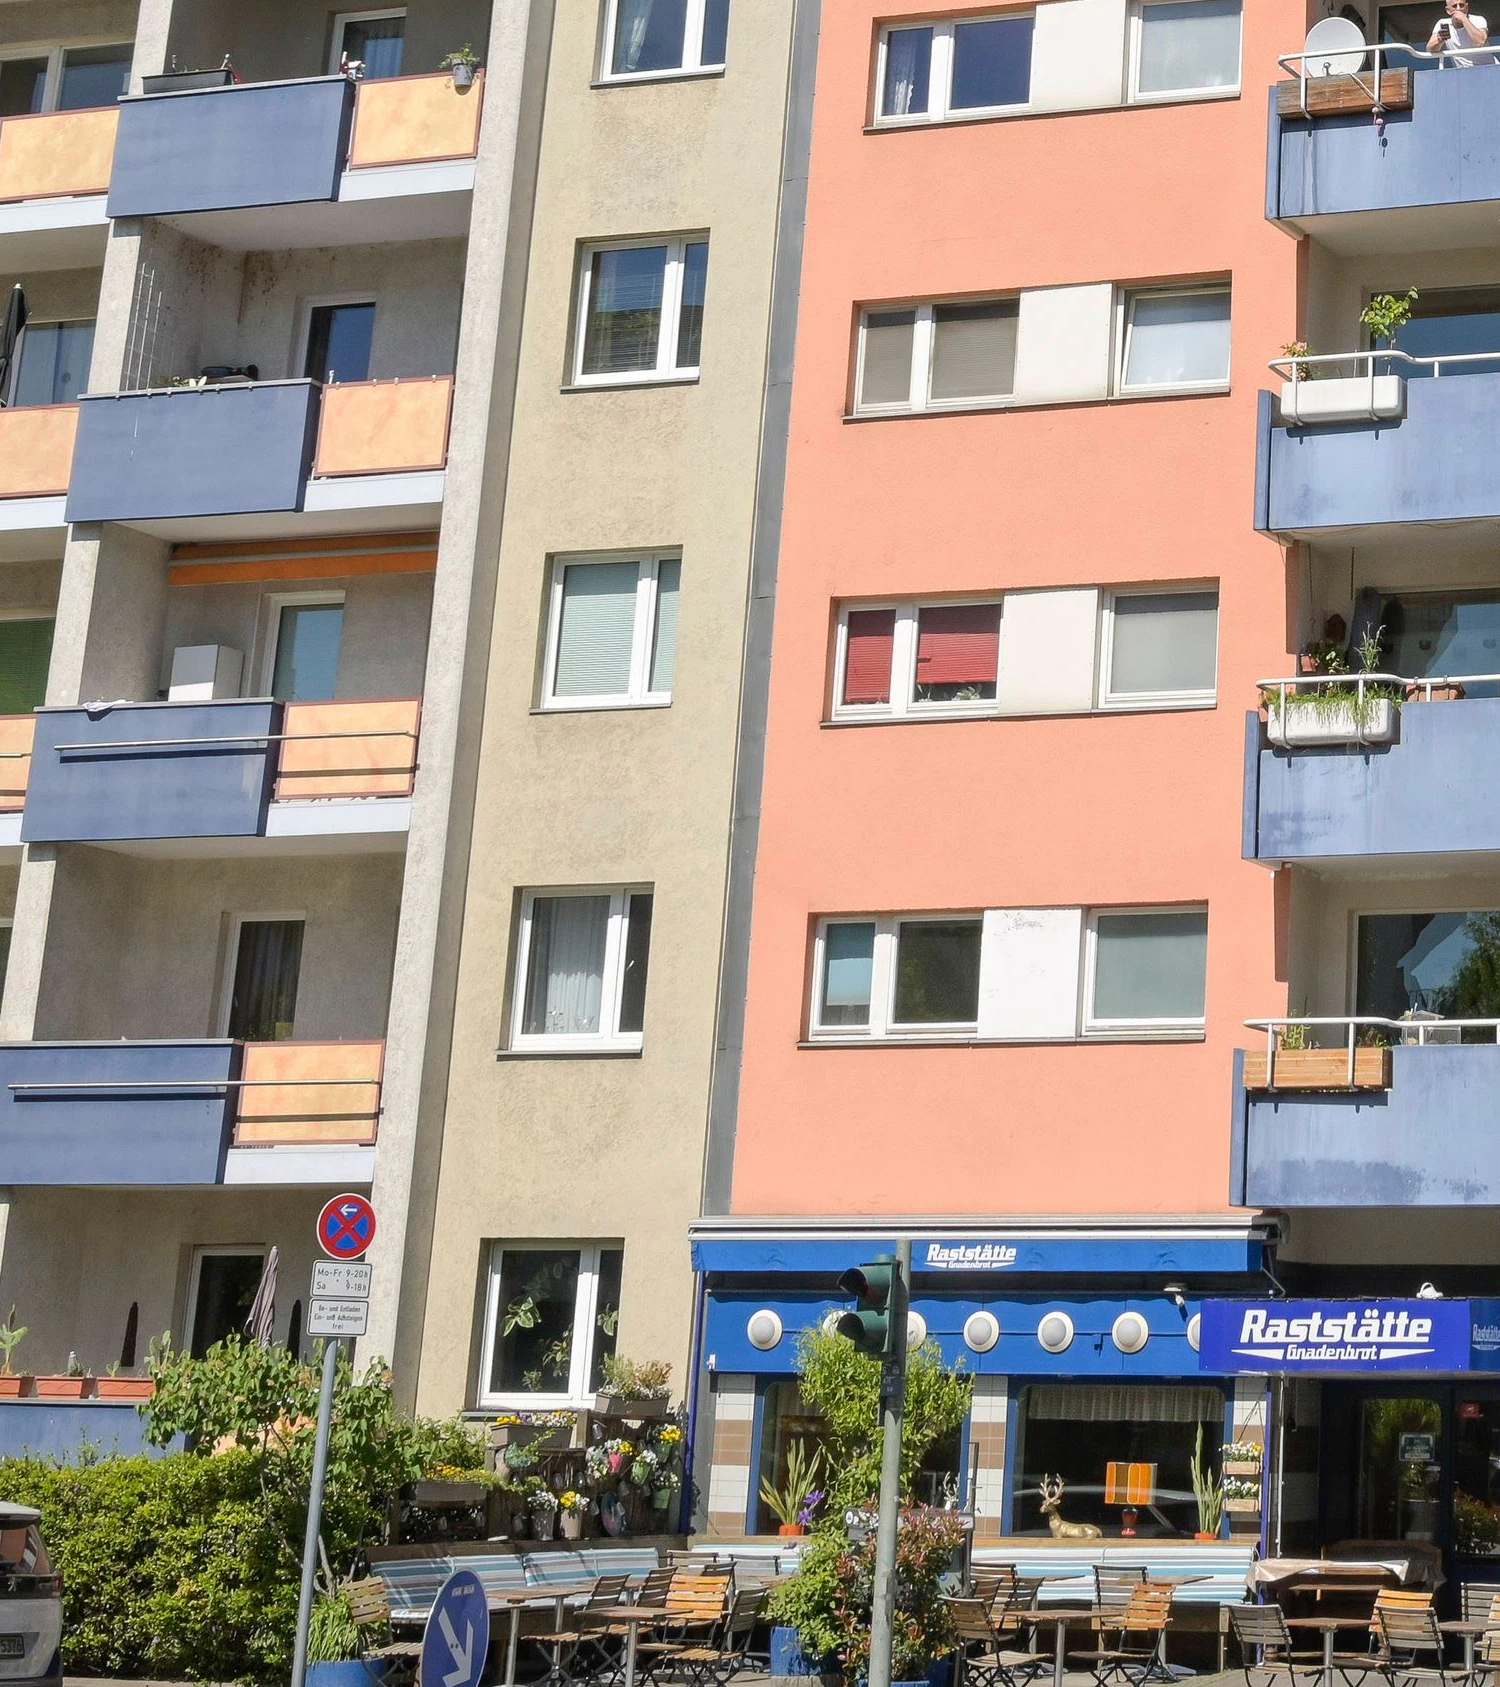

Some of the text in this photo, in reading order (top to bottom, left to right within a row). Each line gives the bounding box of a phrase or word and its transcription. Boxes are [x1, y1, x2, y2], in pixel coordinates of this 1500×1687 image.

[926, 1243, 1017, 1262] Raststätte
[317, 1268, 368, 1278] Mo-Fr 9-20h
[316, 1281, 326, 1290] Sa
[1239, 1309, 1432, 1343] Raststätte
[1286, 1344, 1378, 1360] Gnadenbrot
